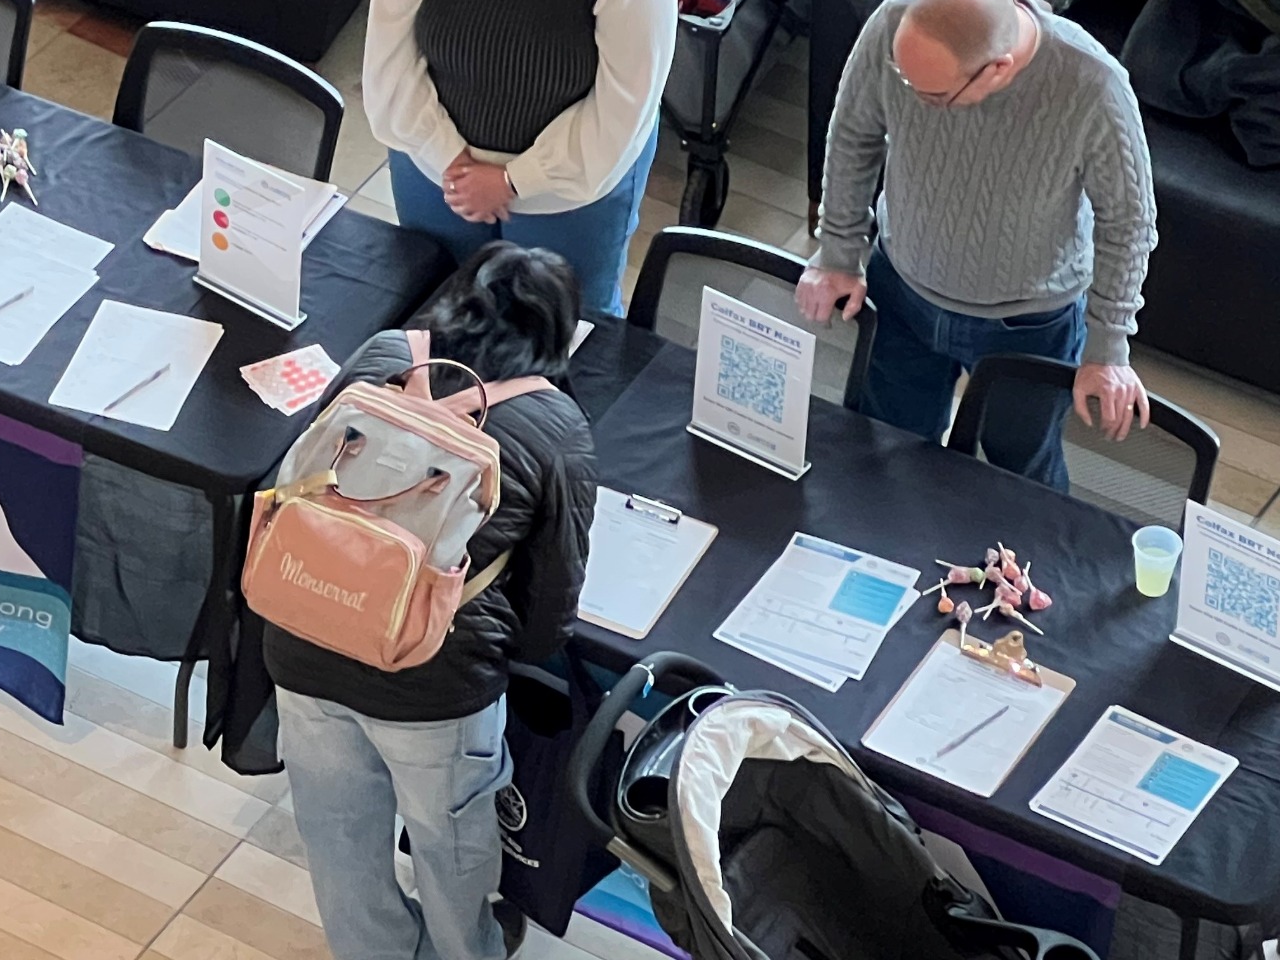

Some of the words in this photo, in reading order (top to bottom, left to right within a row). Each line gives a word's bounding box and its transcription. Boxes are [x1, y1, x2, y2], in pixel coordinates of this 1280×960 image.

[711, 302, 746, 324] Colfax
[749, 319, 772, 334] BRT
[774, 330, 801, 348] Next
[1196, 515, 1235, 539] Colfax
[1238, 534, 1264, 551] BRT
[280, 552, 367, 612] Monserrat
